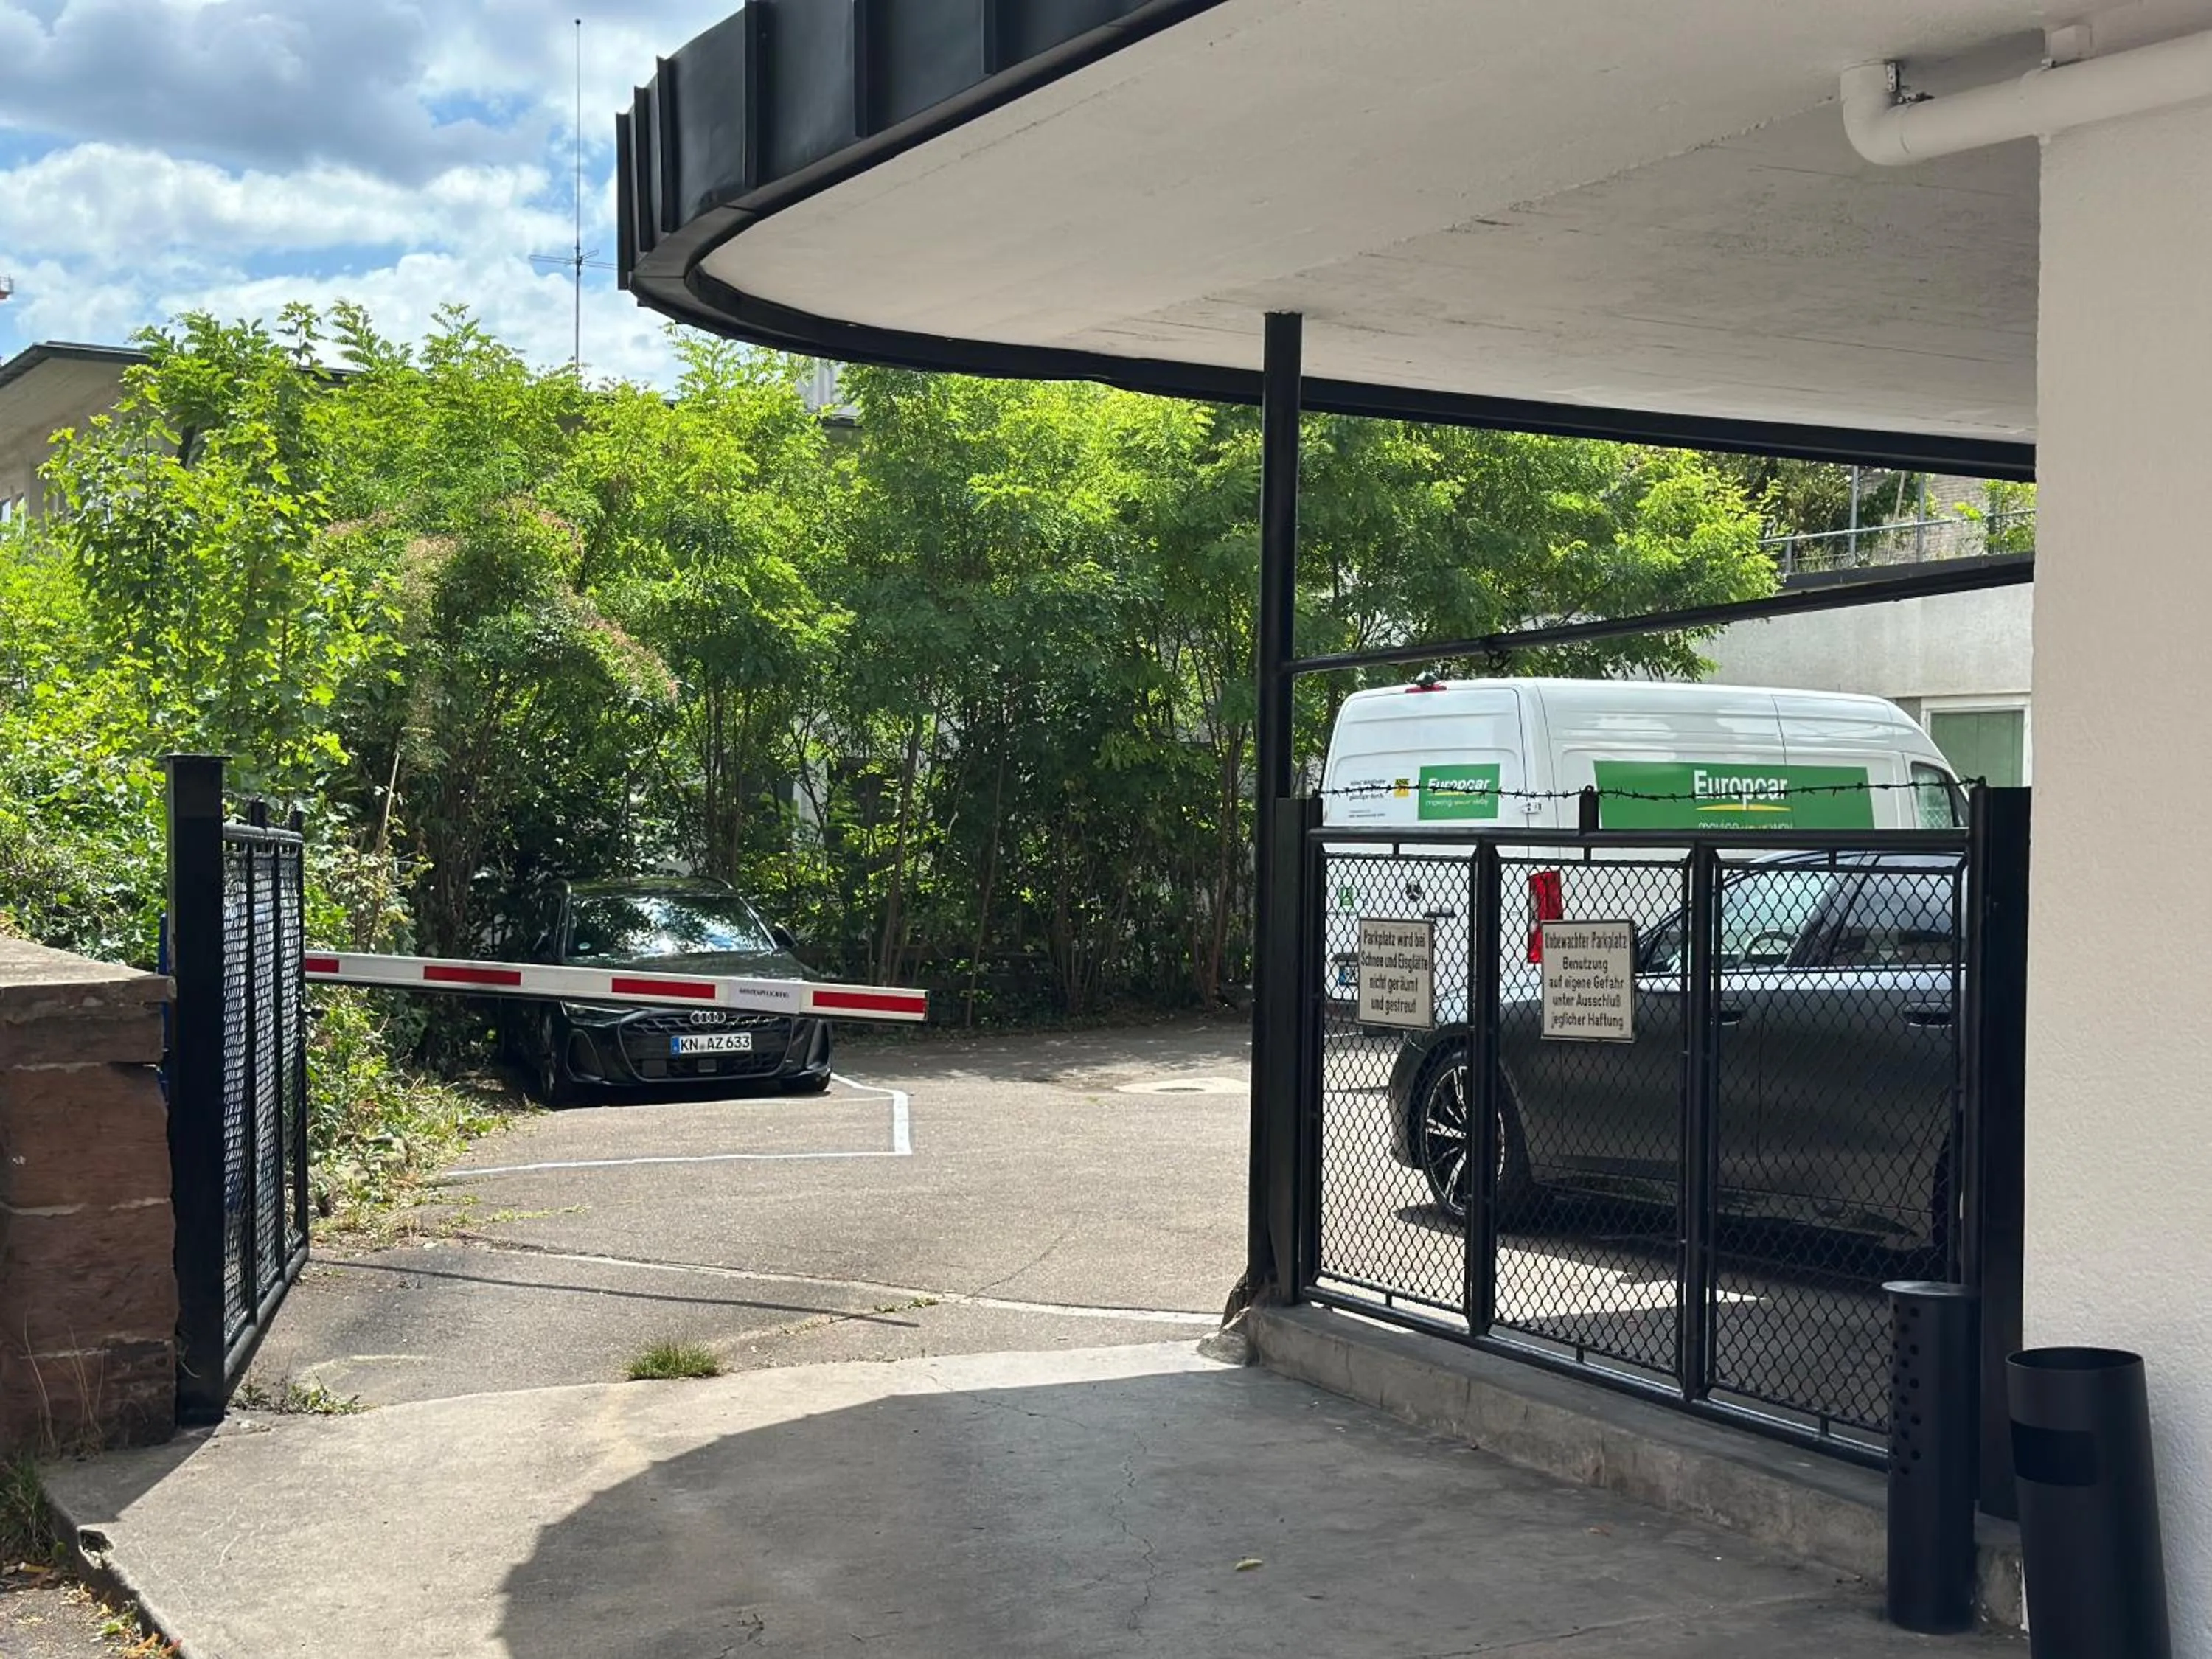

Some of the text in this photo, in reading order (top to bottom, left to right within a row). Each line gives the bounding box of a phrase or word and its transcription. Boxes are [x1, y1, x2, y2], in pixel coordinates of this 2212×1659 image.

[1427, 778, 1491, 792] Europcar
[1694, 770, 1788, 810] Europcar
[1363, 929, 1426, 949] Parkplatz wird bei
[1545, 932, 1627, 954] Unbewachter Parkplatz
[1360, 950, 1428, 973] Schnee und Eisglätte
[1562, 956, 1609, 973] Benutzung
[1369, 973, 1387, 989] nicht
[1388, 976, 1418, 994] geräumt
[1548, 975, 1624, 991] auf eigene Gefahr
[1371, 995, 1416, 1015] und gestreut
[1552, 993, 1621, 1007] unter Ausschluß
[1551, 1011, 1624, 1030] jeglicher Haftung
[681, 1037, 698, 1051] KN
